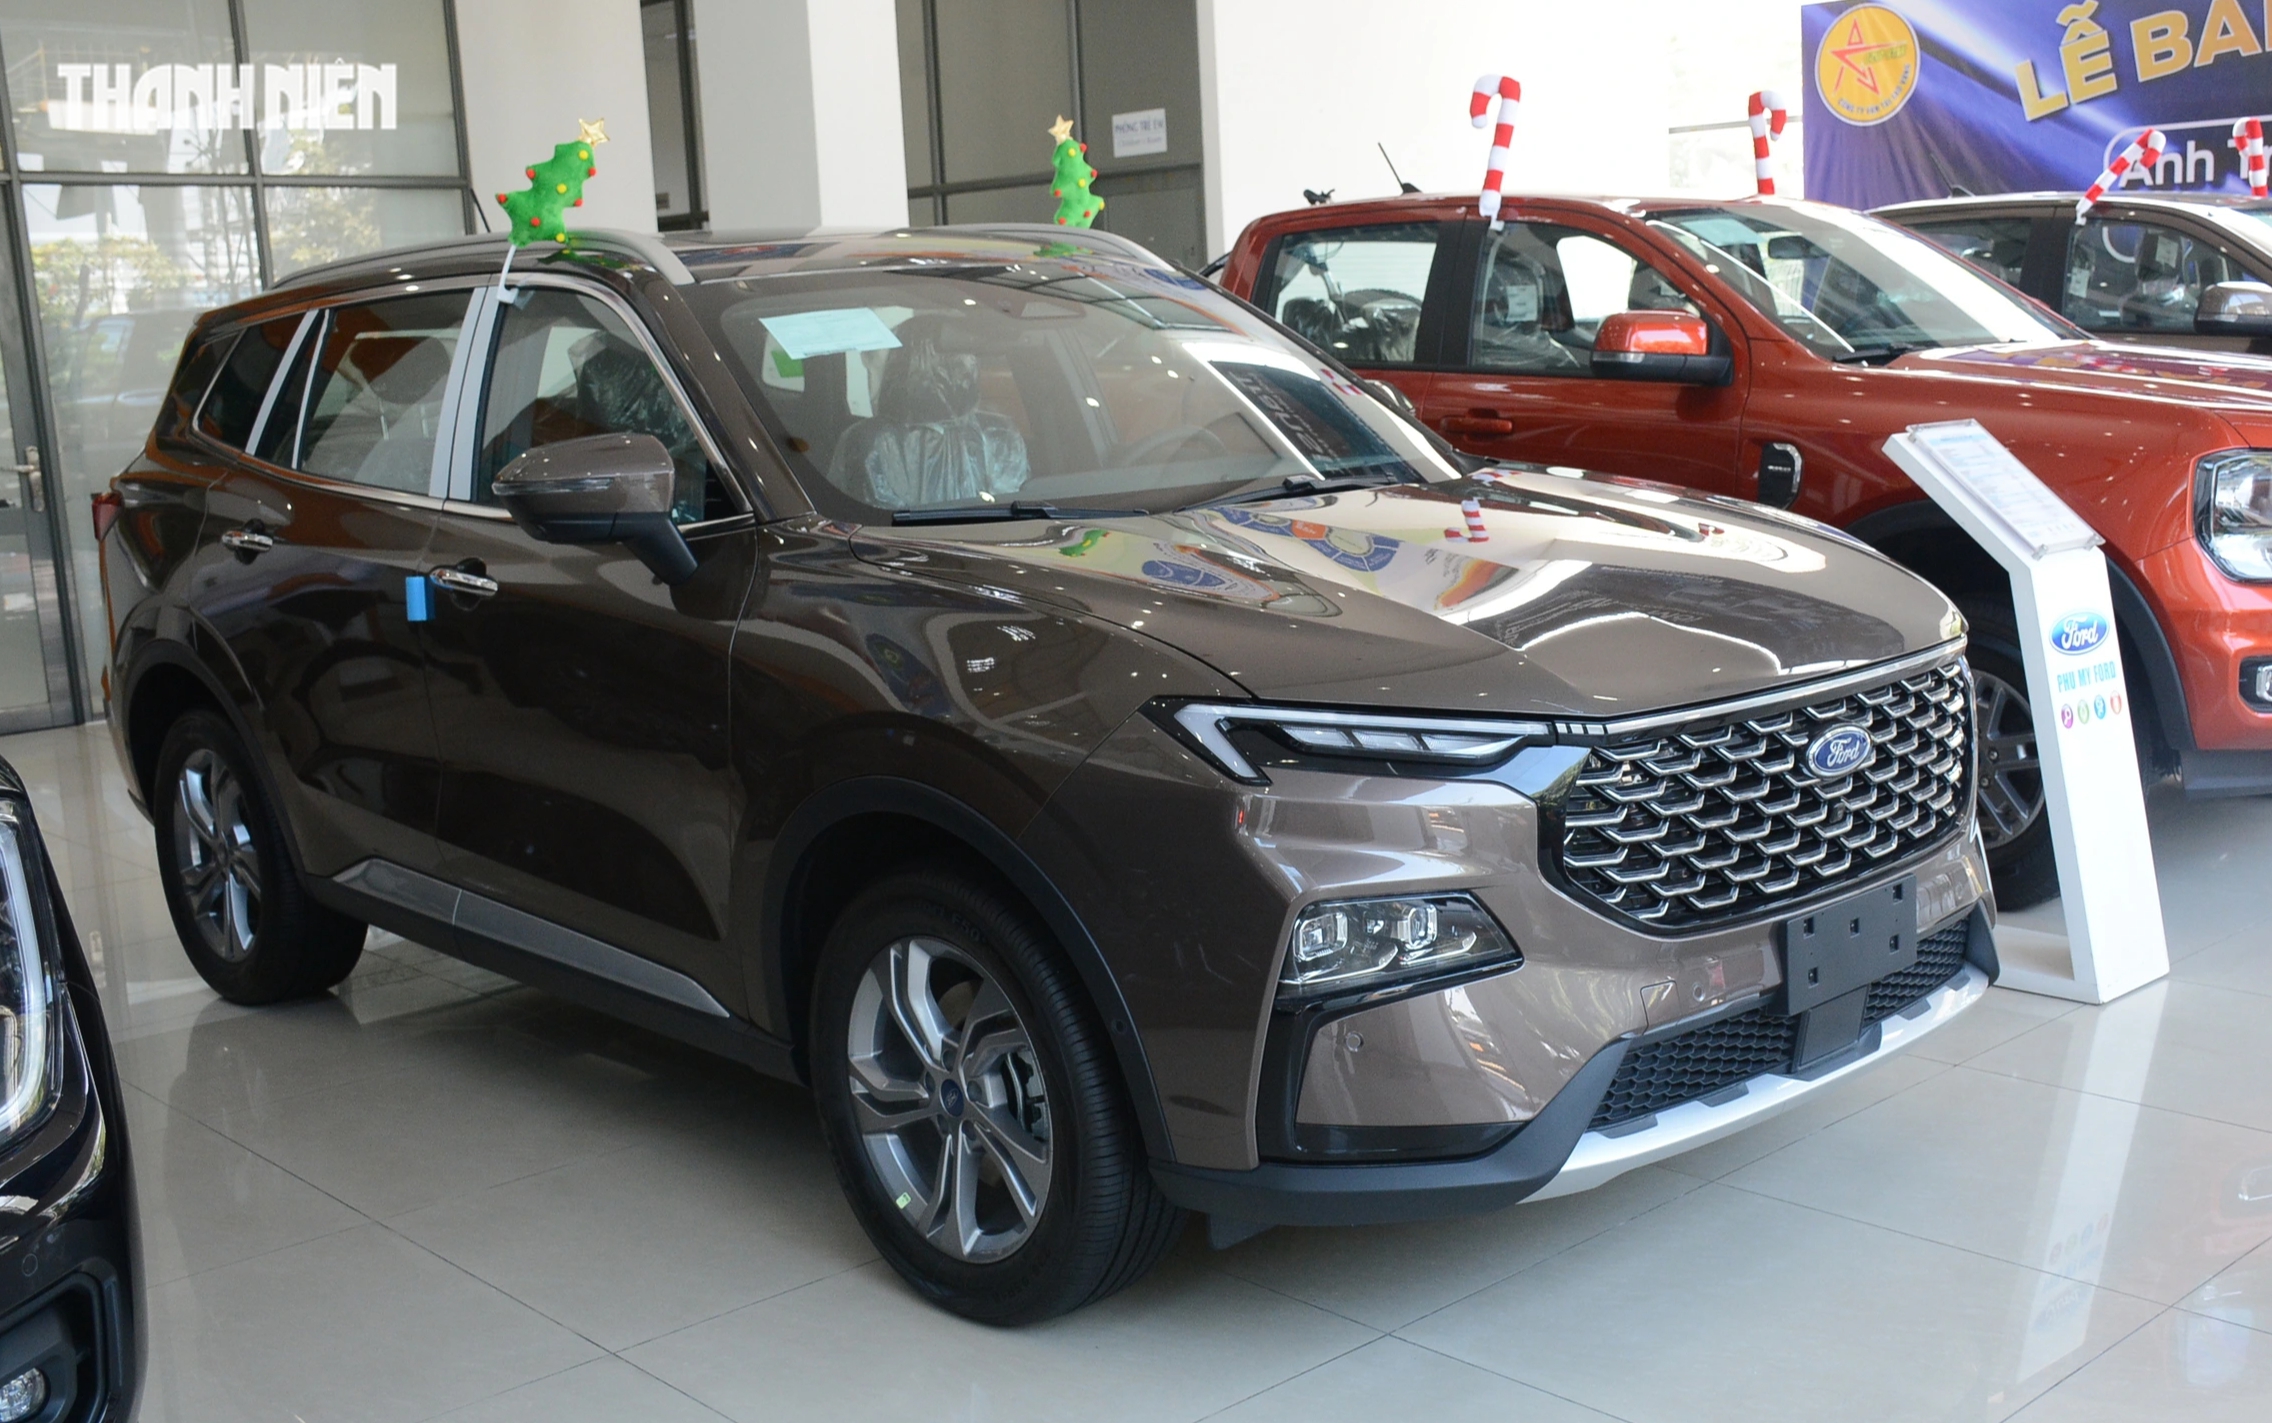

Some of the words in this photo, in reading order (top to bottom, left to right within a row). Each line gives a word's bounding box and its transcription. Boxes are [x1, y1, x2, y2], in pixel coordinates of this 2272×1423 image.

[2014, 0, 2118, 121] LỄ
[2130, 0, 2272, 82] BA
[2061, 616, 2099, 649] Ford
[2057, 671, 2076, 693] PHU
[2078, 667, 2091, 687] MY
[2094, 661, 2116, 683] FORD
[1827, 737, 1860, 767] Ford
